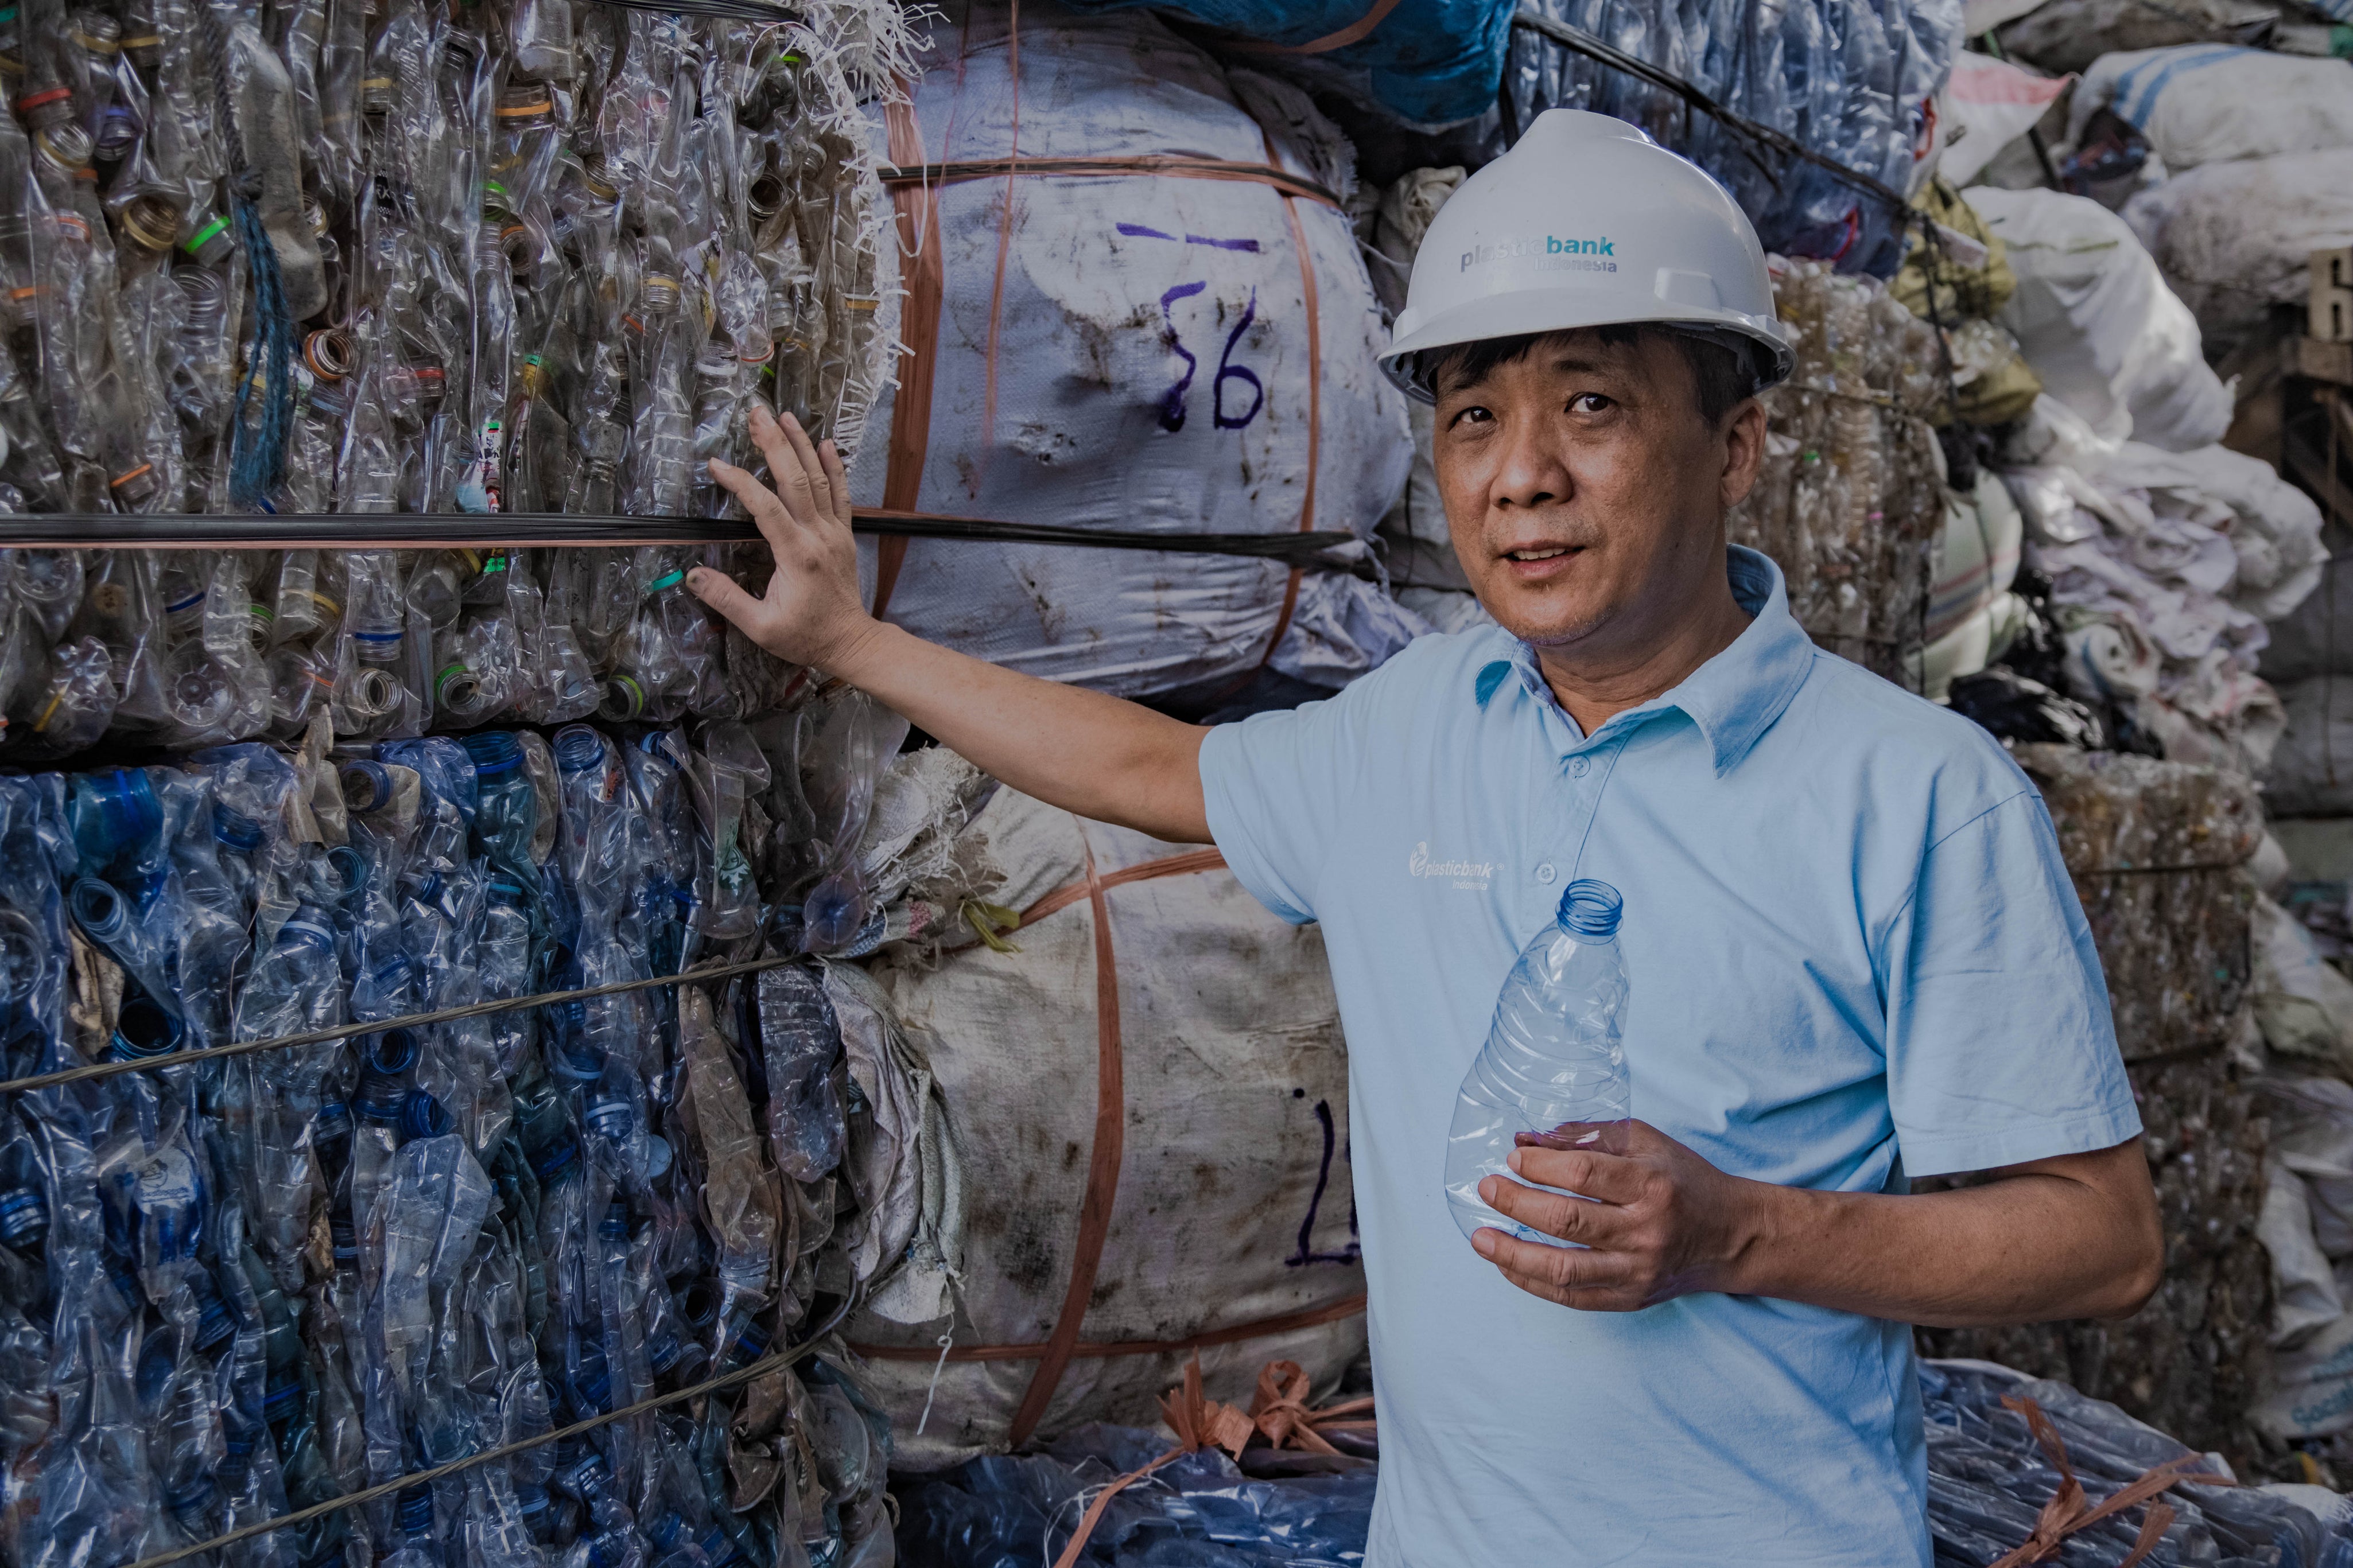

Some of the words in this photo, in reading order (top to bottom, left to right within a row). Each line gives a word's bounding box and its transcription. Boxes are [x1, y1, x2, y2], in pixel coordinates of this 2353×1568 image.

[1533, 257, 1617, 273] Indonesia
[1424, 860, 1494, 879] plasticbank
[1452, 880, 1488, 890] Indonesia
